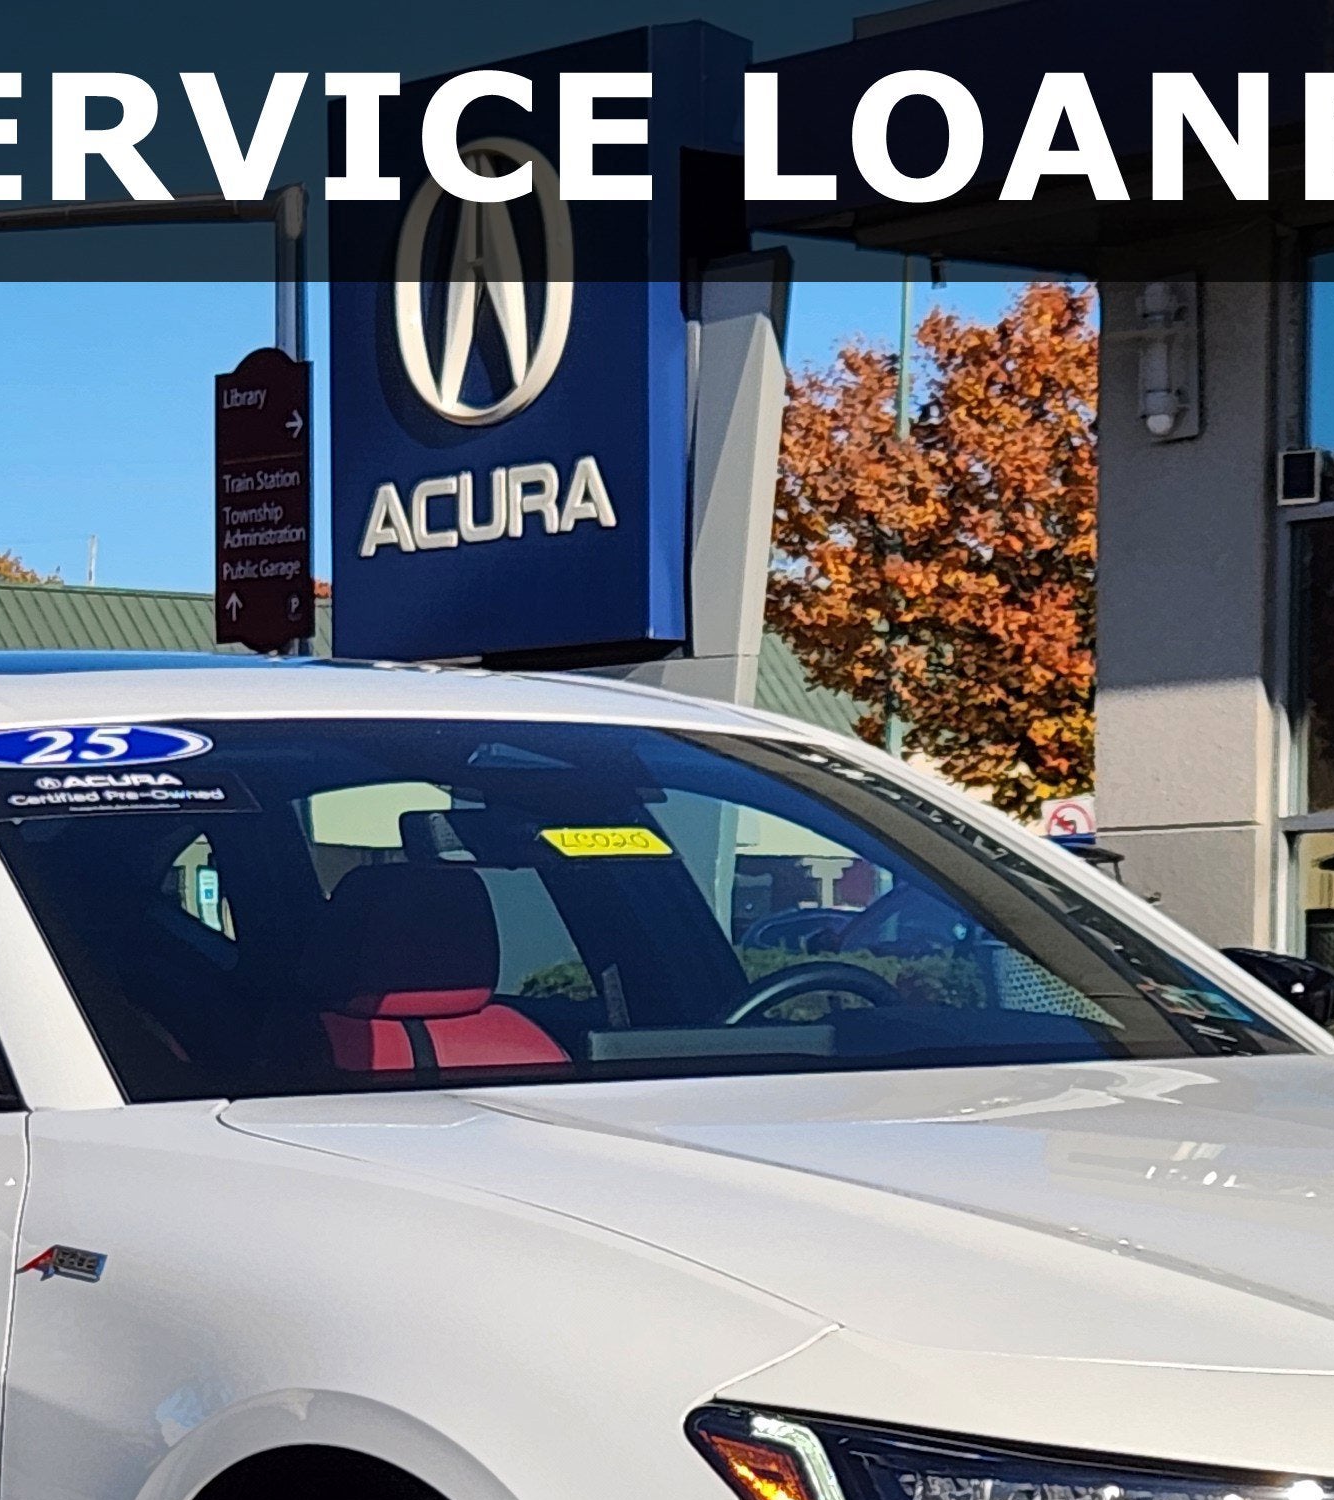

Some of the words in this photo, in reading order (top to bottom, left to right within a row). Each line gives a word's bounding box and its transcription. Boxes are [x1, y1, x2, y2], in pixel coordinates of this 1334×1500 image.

[222, 389, 267, 410] Library
[223, 476, 254, 493] Train
[256, 469, 301, 489] Station
[223, 502, 284, 525] Township
[359, 454, 618, 557] ACURA
[223, 524, 306, 550] Administration
[223, 560, 259, 581] Public
[259, 559, 301, 580] Garage
[21, 727, 133, 764] 25
[62, 773, 183, 789] ACURA
[7, 791, 100, 805] Certified
[103, 787, 226, 801] Pre-Owned
